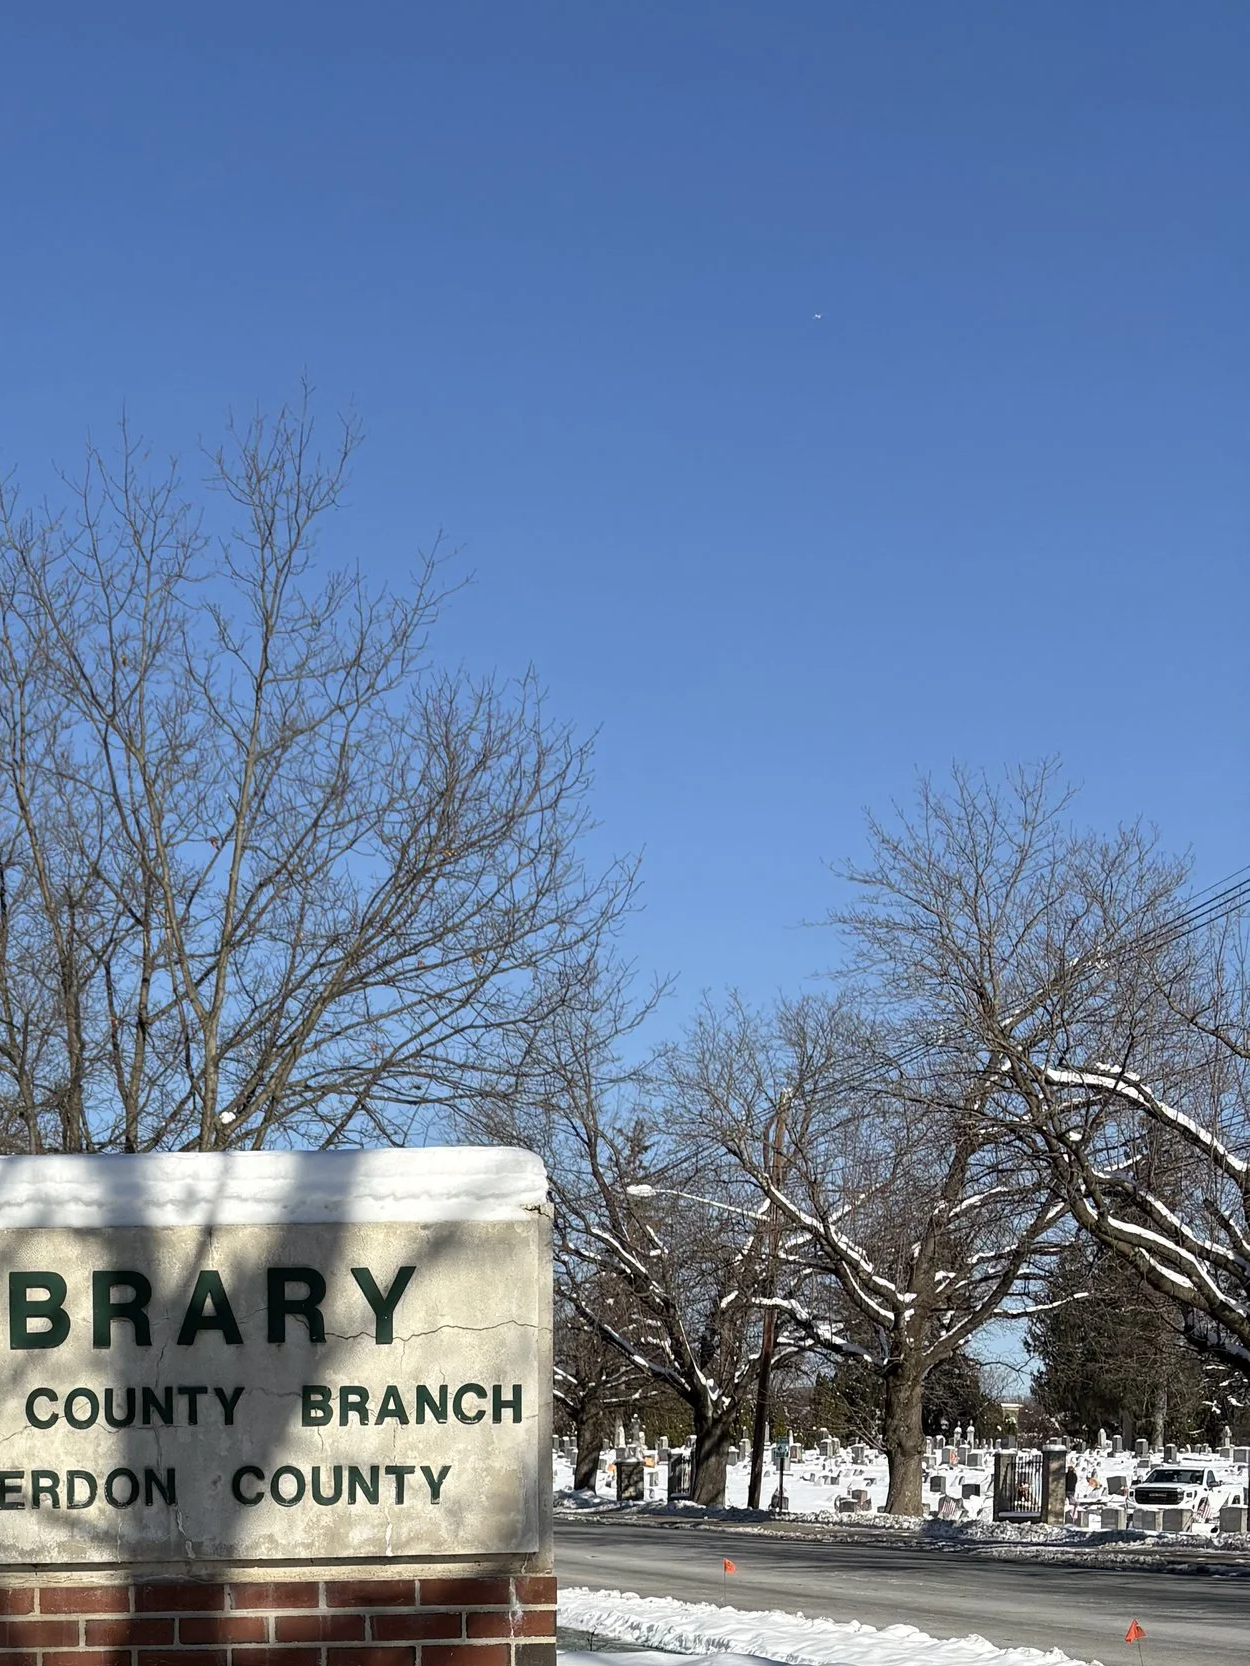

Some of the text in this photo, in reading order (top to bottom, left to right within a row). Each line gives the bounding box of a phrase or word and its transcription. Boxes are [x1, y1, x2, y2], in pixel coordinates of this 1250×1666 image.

[25, 1386, 246, 1430] COUNTY
[301, 1382, 524, 1427] BRANCH
[231, 1464, 452, 1506] COUNTY
